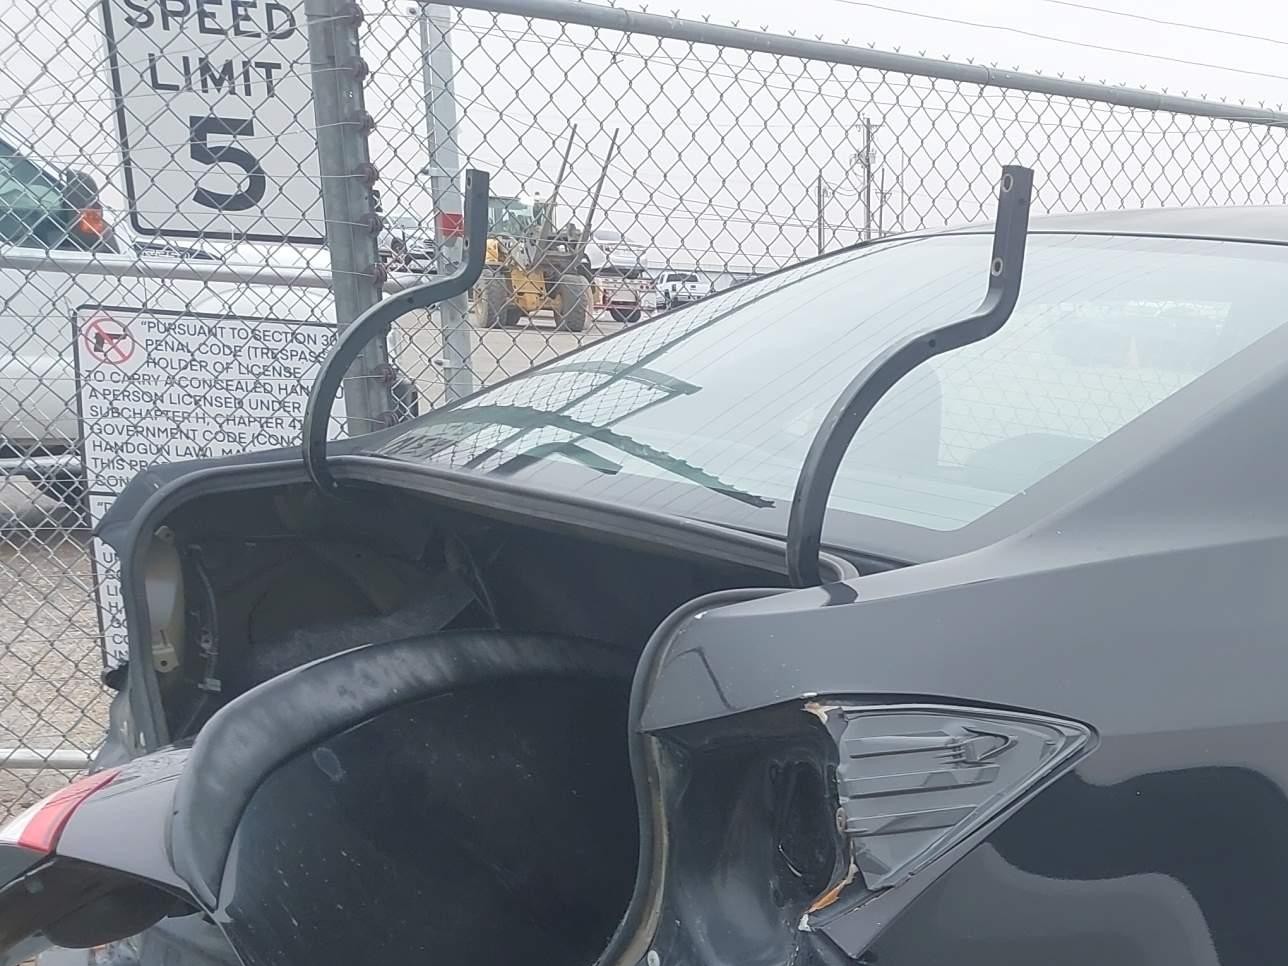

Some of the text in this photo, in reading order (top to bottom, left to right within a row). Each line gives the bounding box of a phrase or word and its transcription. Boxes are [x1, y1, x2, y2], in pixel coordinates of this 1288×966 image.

[125, 0, 297, 40] SPEED
[149, 53, 282, 98] LIMIT
[190, 115, 267, 212] 5
[145, 339, 192, 354] PENAL
[199, 342, 242, 358] CODE
[230, 327, 249, 340] TO
[253, 328, 317, 346] SECTION
[146, 355, 302, 379] HOLDER OF LICENSE
[85, 369, 106, 383] TO
[110, 371, 161, 386] CARRY
[178, 375, 274, 394] CONCEALED
[89, 388, 302, 414] A PERSON LICENSED UNDER
[90, 405, 191, 424] SUBCHAPTER
[215, 413, 285, 430] CHAPTER
[92, 422, 199, 441] GOVERNMENT
[203, 429, 247, 444] CODE
[93, 440, 171, 457] HANDGUN
[91, 457, 126, 471] THIS
